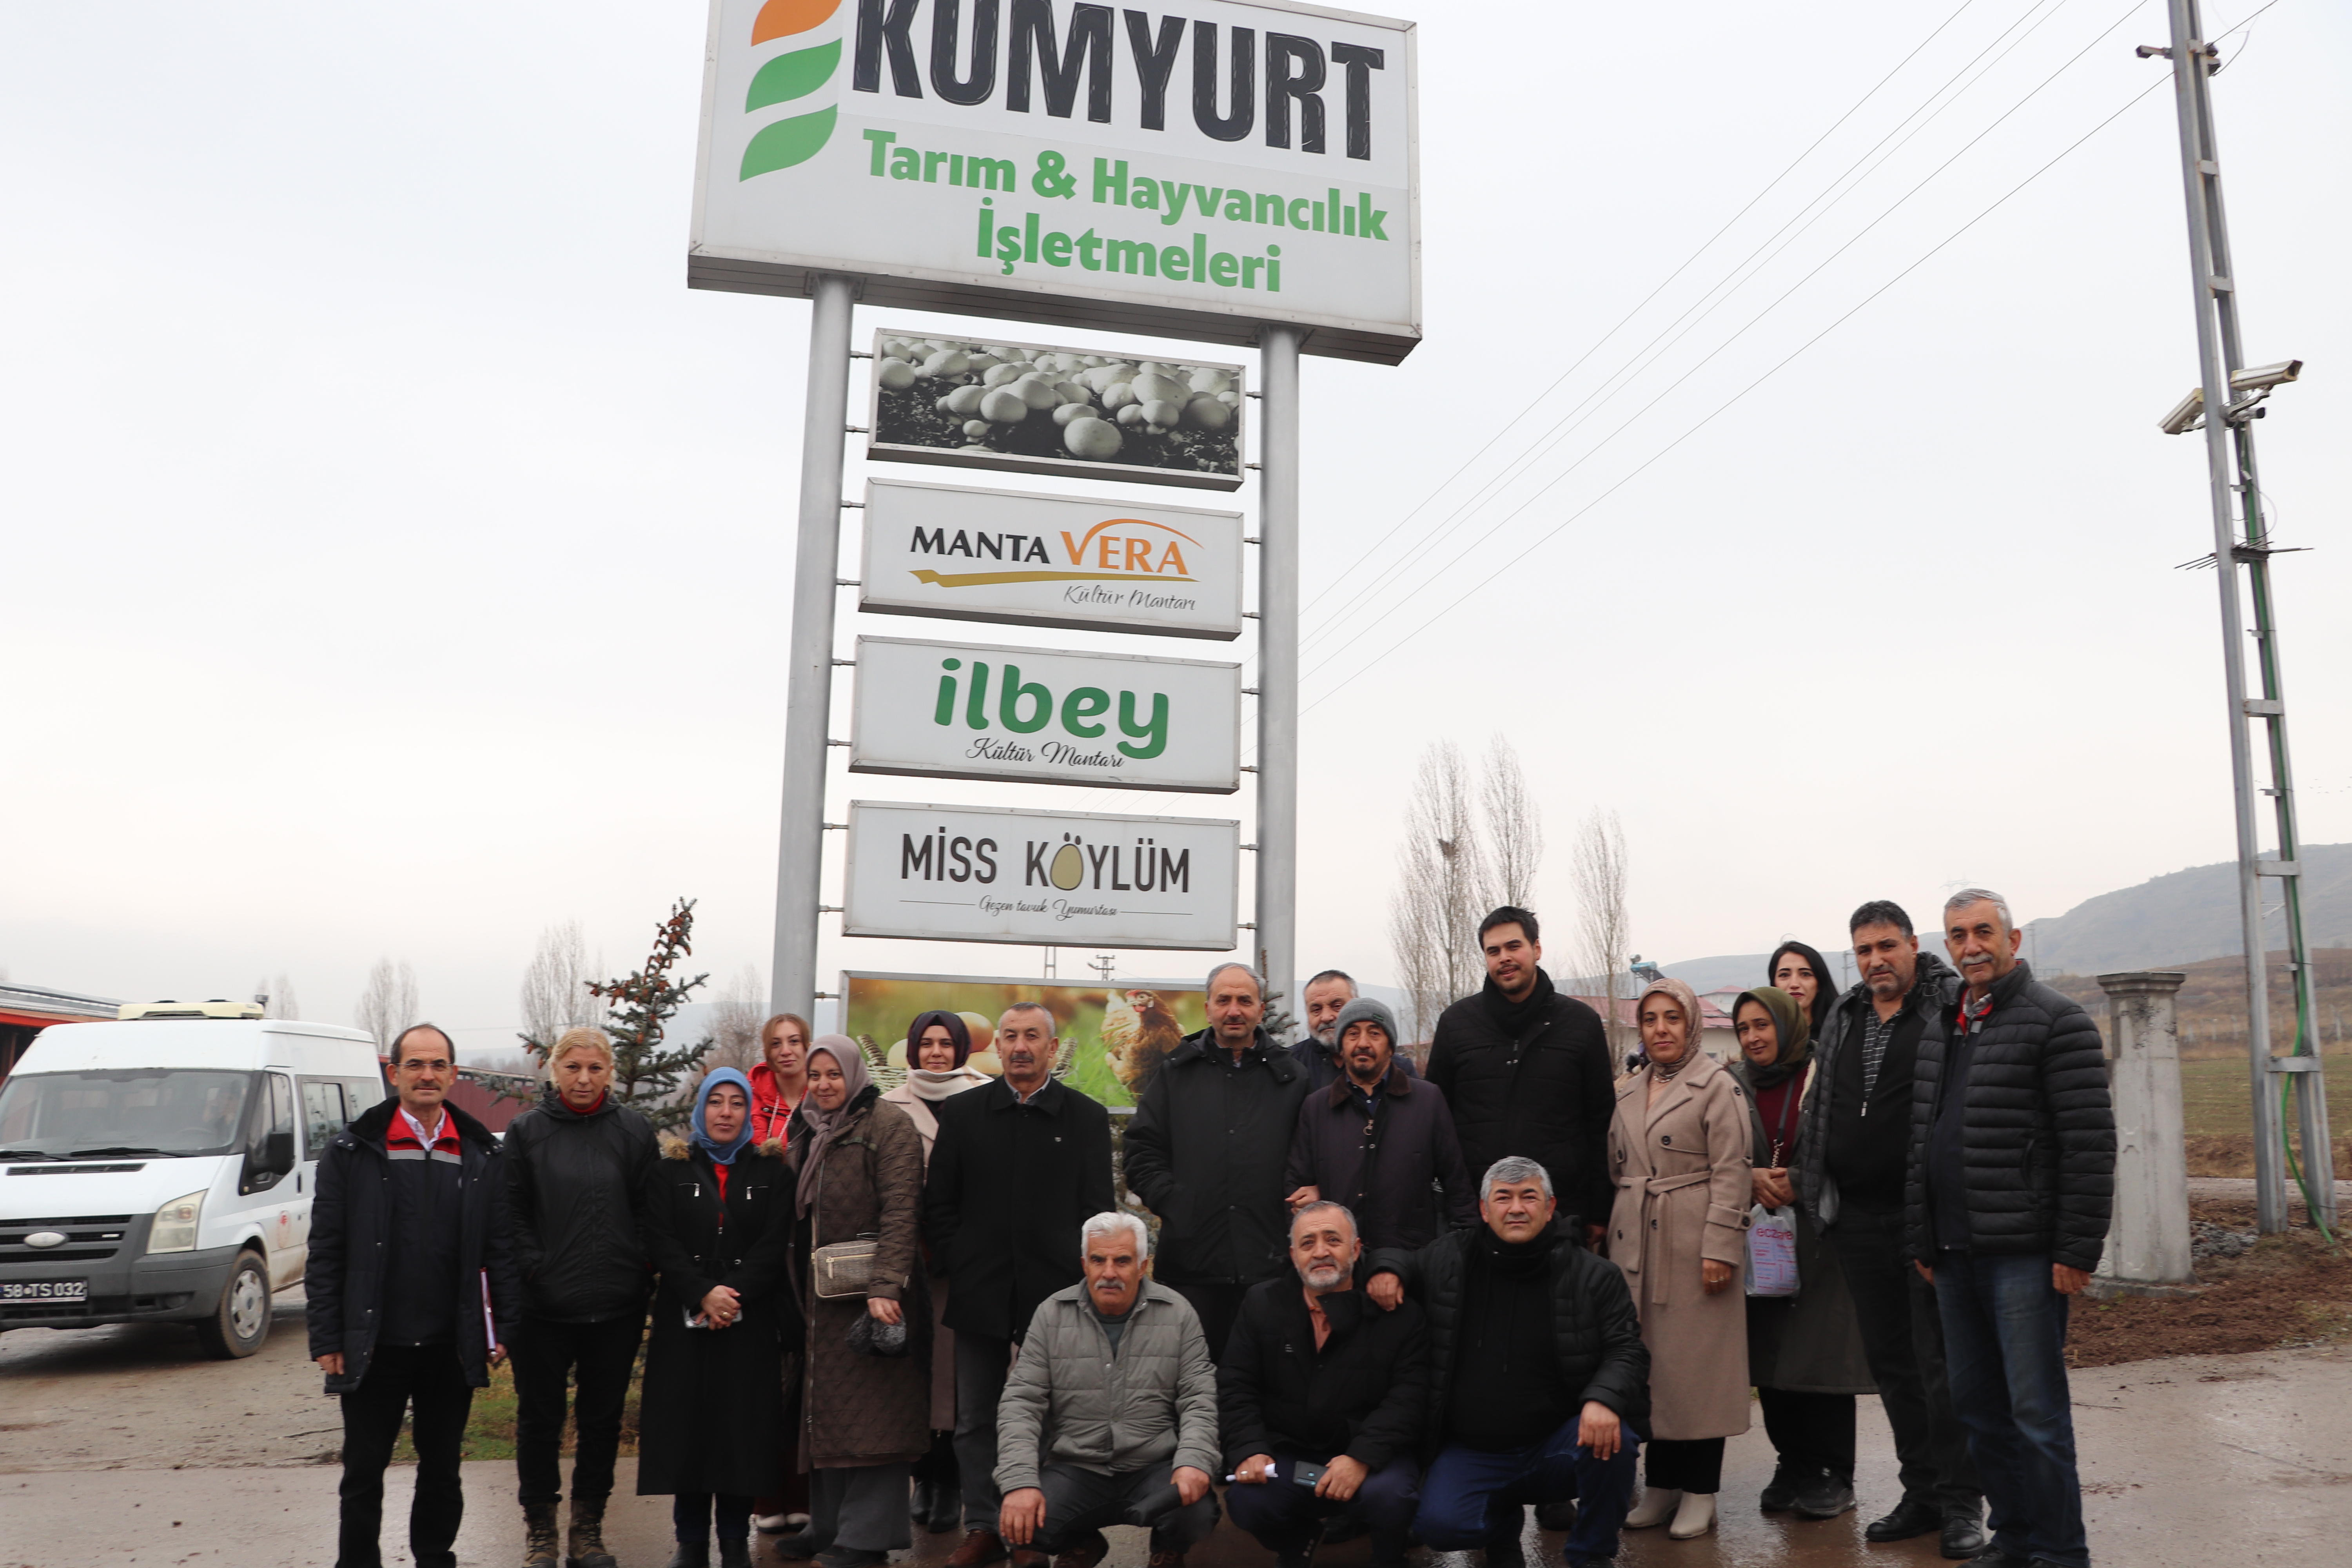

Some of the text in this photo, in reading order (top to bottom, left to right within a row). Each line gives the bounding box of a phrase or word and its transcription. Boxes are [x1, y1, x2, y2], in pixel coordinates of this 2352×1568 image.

[864, 129, 1388, 241] Tarım & Hayvancılık
[977, 197, 1280, 292] İşletmeleri
[910, 526, 1189, 576] MANTA VERA
[1063, 584, 1196, 611] Kültür Mantarı
[935, 658, 1169, 759] ilbey
[965, 737, 1125, 768] Kültür Mantarı
[901, 826, 1190, 893] MİSS KÖYLÜM
[979, 895, 1117, 921] Gezen tavuk Yumurtası
[3, 1282, 84, 1298] 58 TS 032
